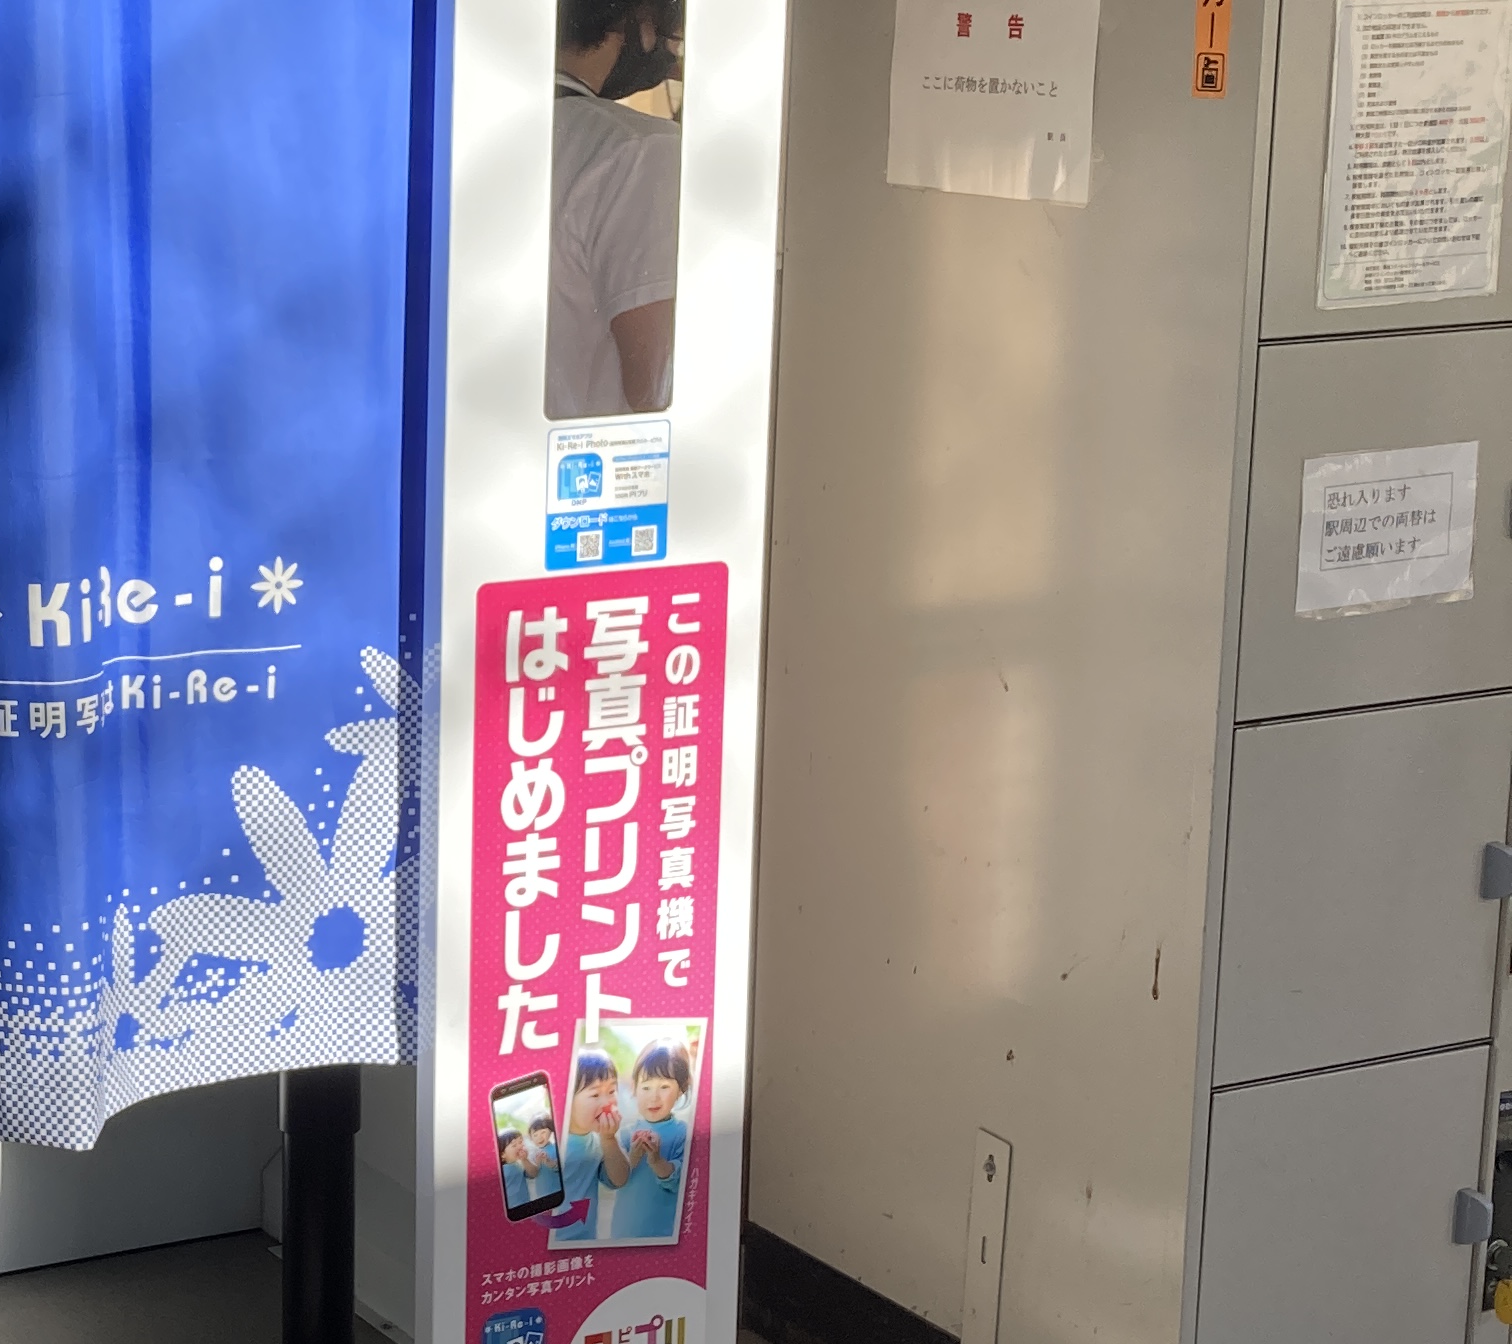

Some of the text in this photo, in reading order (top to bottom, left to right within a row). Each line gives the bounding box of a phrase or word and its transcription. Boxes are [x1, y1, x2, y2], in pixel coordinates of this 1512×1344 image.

[921, 75, 1059, 98] ここに荷物を置かないこと
[1327, 484, 1412, 510] 恐れ入ります
[1324, 508, 1437, 537] 駅周辺での両替は
[1325, 536, 1422, 563] ご遠慮願います
[656, 592, 701, 988] この証明写真機で
[497, 606, 569, 1056] はじめました
[580, 595, 650, 1045] 写真プリント
[481, 1254, 594, 1286] スマホの撮影画像を
[481, 1272, 596, 1305] カンタン写真プリント
